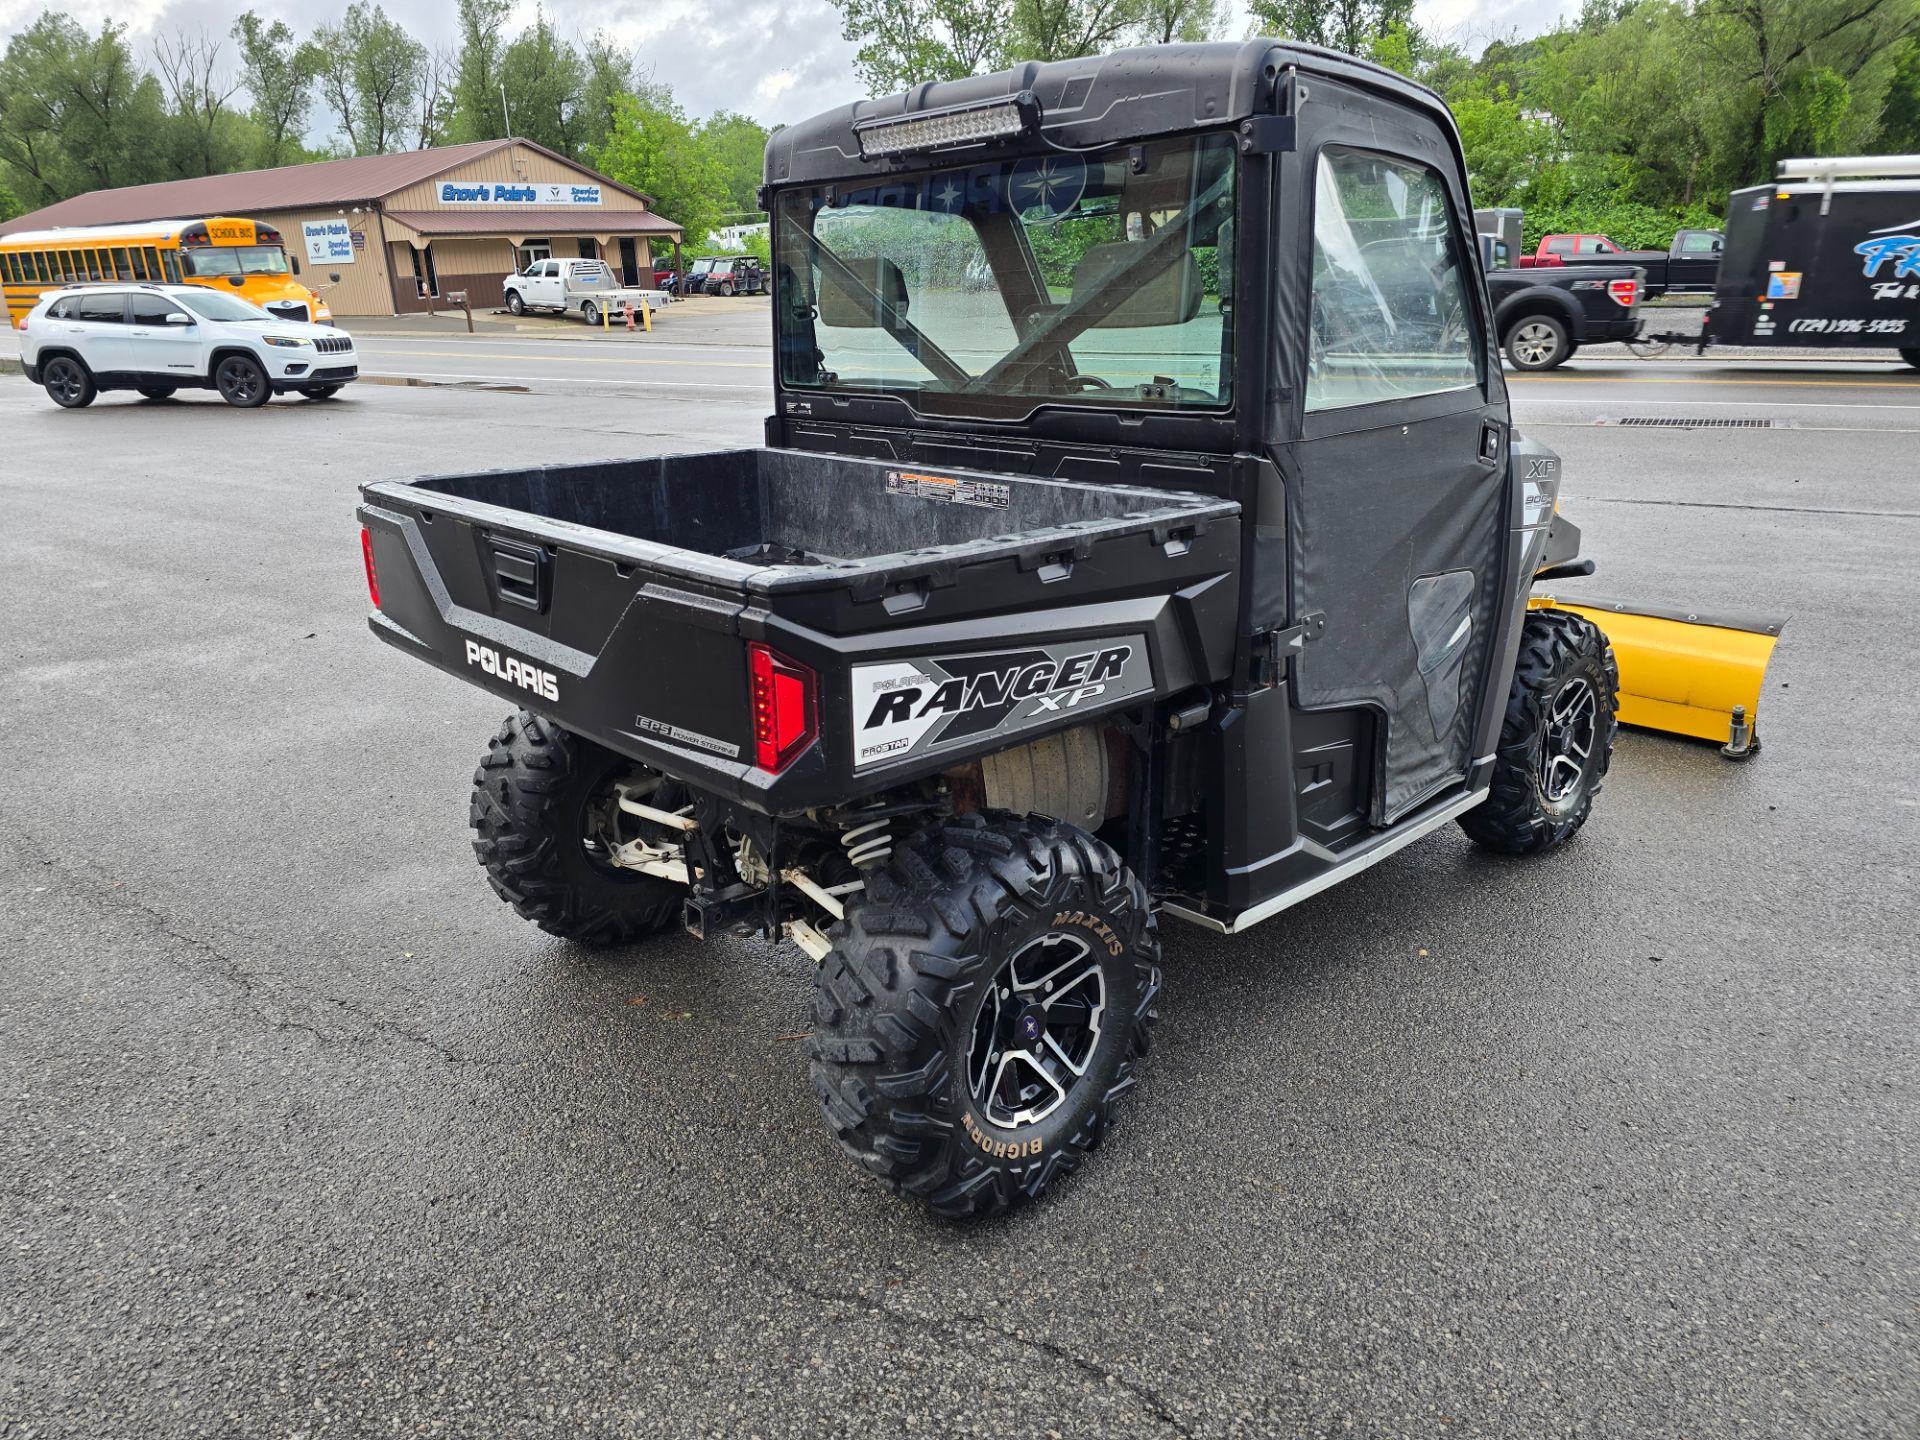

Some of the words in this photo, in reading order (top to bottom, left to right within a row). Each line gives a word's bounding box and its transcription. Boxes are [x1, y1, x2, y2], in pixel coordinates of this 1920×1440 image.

[494, 185, 536, 202] Polaris
[211, 227, 239, 239] SCHOOL
[239, 227, 254, 239] BUS
[1525, 459, 1555, 479] XP
[465, 639, 559, 702] POLARIS
[863, 645, 1132, 731] RANGER
[872, 673, 931, 693] POLARIS
[1021, 684, 1106, 720] XP
[639, 718, 671, 735] EPS
[673, 731, 701, 745] POWER
[700, 740, 737, 757] STEERING
[861, 737, 909, 758] PROSTAR
[1050, 910, 1124, 957] MAXXIS
[960, 1111, 1043, 1160] BIGHORN
